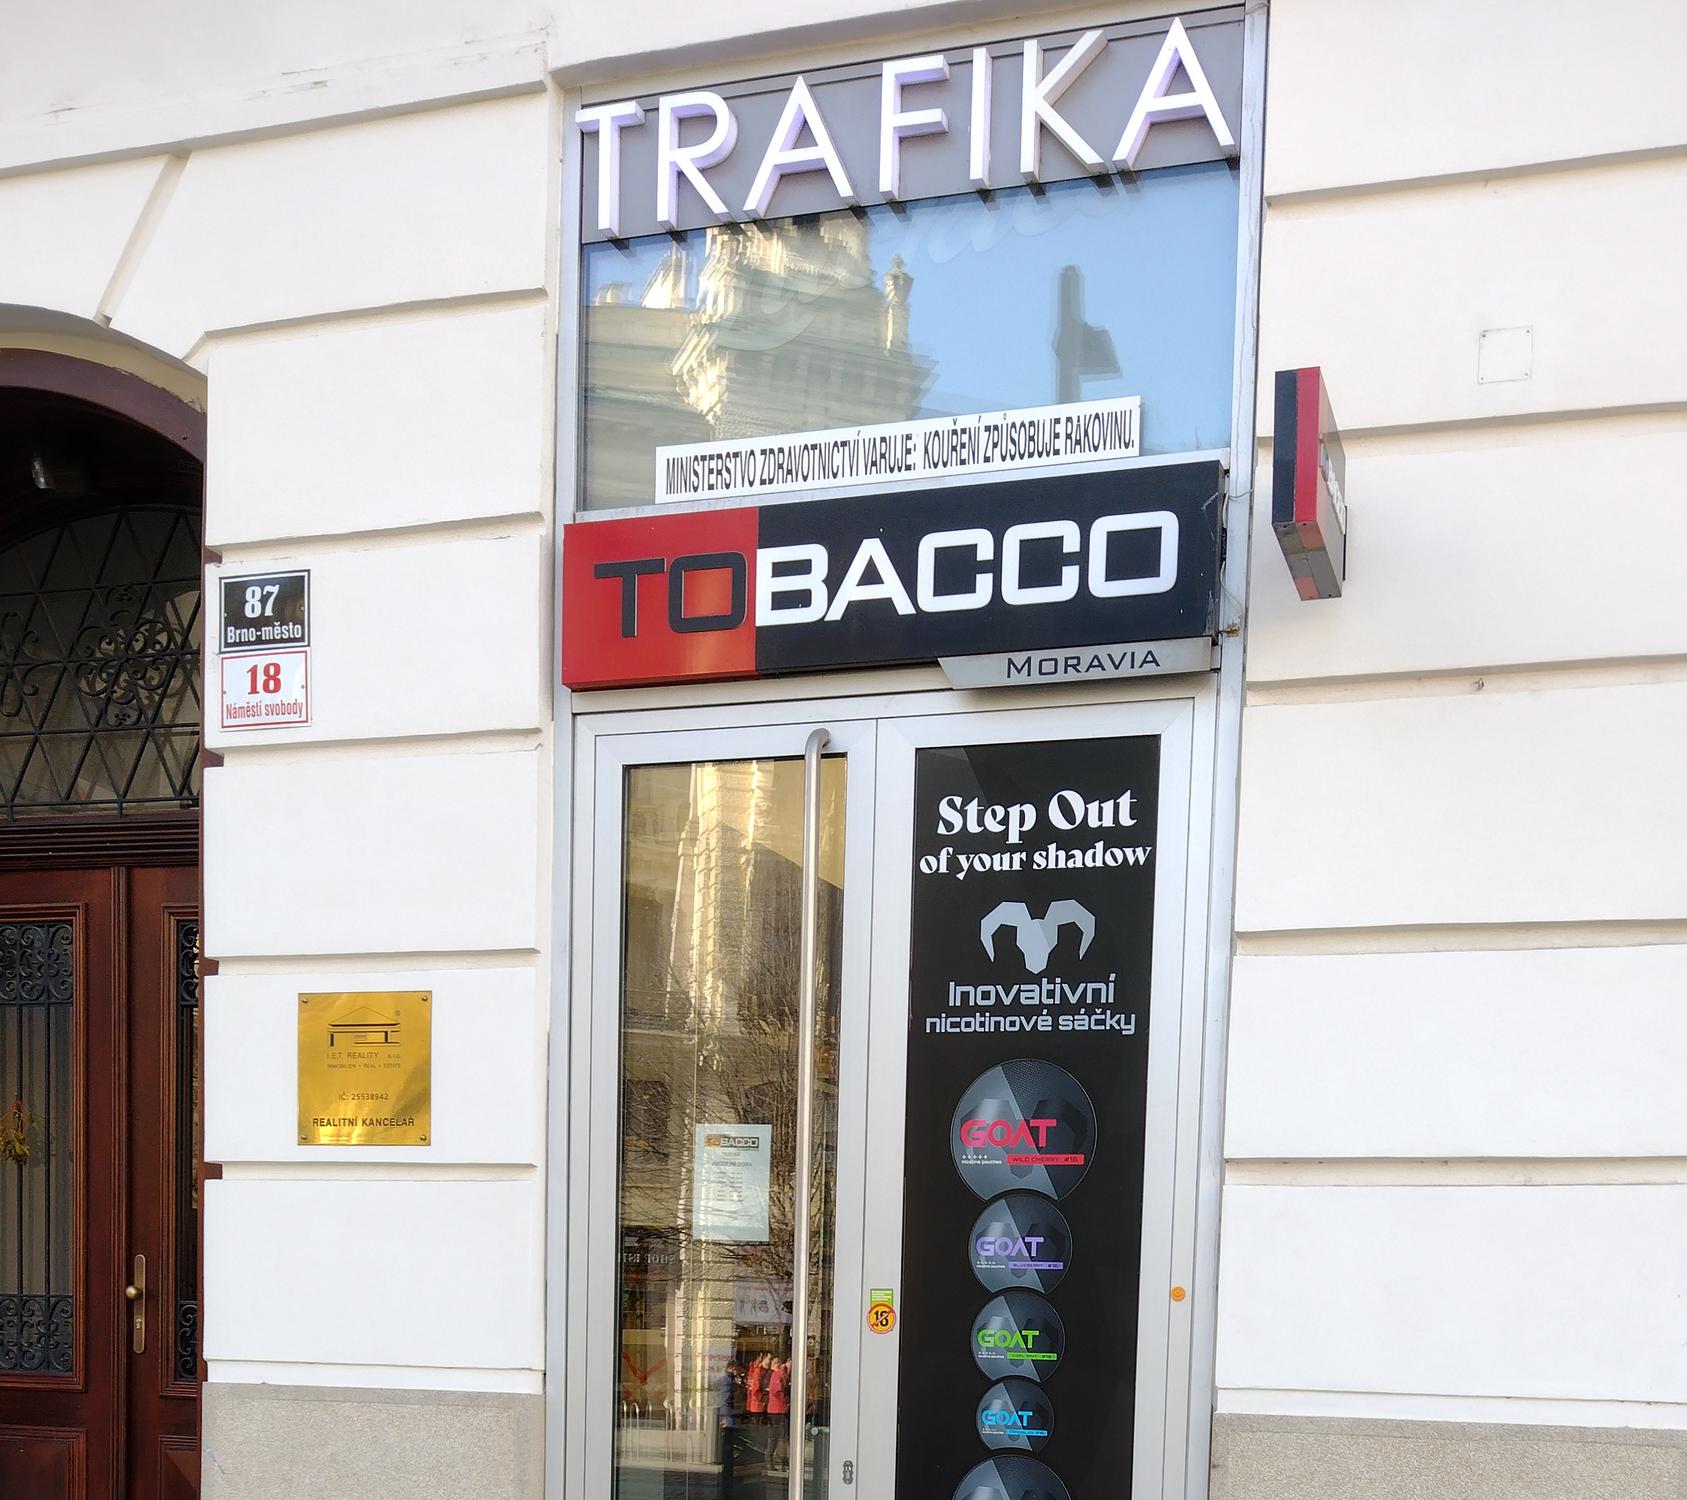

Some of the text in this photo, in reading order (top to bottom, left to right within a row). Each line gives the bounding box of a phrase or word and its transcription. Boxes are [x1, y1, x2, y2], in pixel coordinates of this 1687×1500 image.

[575, 16, 1235, 238] TRAFIKA
[665, 449, 757, 496] MINISTERSTVO
[759, 430, 862, 486] ZDRAVOTNICTVÍ
[862, 433, 917, 475] VARUJE:
[923, 415, 982, 470] KOUŘENÍ
[983, 412, 1061, 463] ZPŮSOBUJE
[594, 510, 1180, 639] TOBACCO
[244, 584, 280, 618] 87
[226, 621, 302, 643] Brno-město
[1006, 649, 1161, 679] MORAVIA
[246, 662, 282, 696] 18
[225, 698, 304, 720] Náměstí svobody
[937, 789, 1138, 844] Step Out
[919, 840, 1152, 881] of your shadow
[948, 973, 1117, 1007] Inovativní
[925, 1008, 1136, 1035] nicotinové sáčky
[346, 1051, 379, 1060] REALITY
[312, 1115, 359, 1127] REALITNÍ
[960, 1119, 1057, 1148] GOAT
[976, 1236, 1044, 1257] GOAT
[977, 1328, 1040, 1349] GOAT
[981, 1409, 1033, 1427] GOAT
